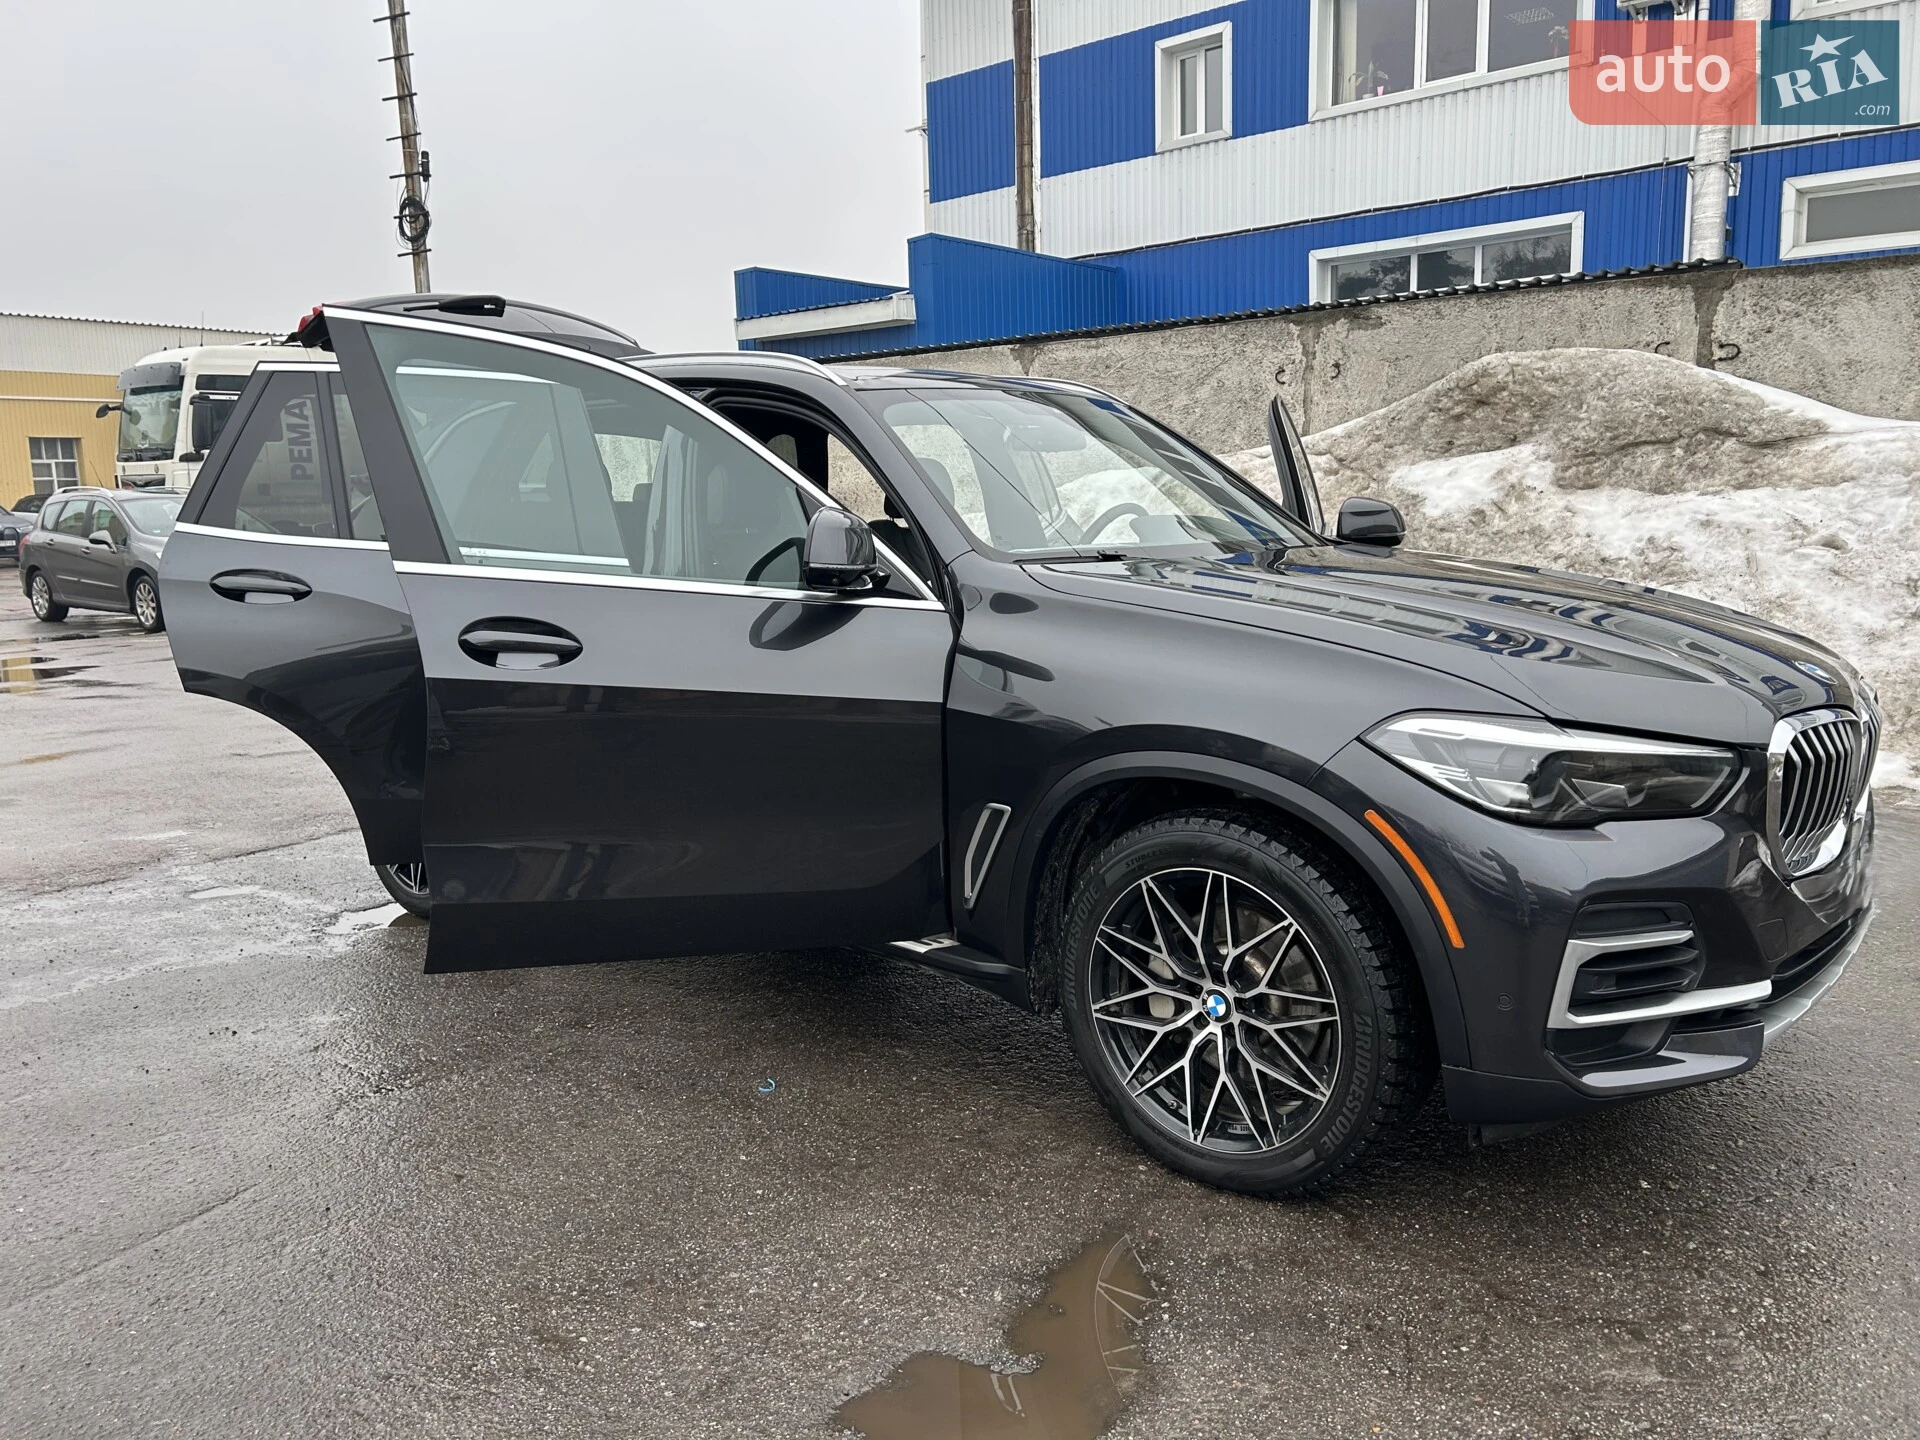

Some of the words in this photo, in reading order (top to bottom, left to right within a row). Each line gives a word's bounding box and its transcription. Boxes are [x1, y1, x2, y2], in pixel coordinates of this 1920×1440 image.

[284, 400, 314, 480] PEMA
[1064, 883, 1100, 1010] BRIDGESTONE
[1320, 1012, 1373, 1153] BRIDGESTONE
